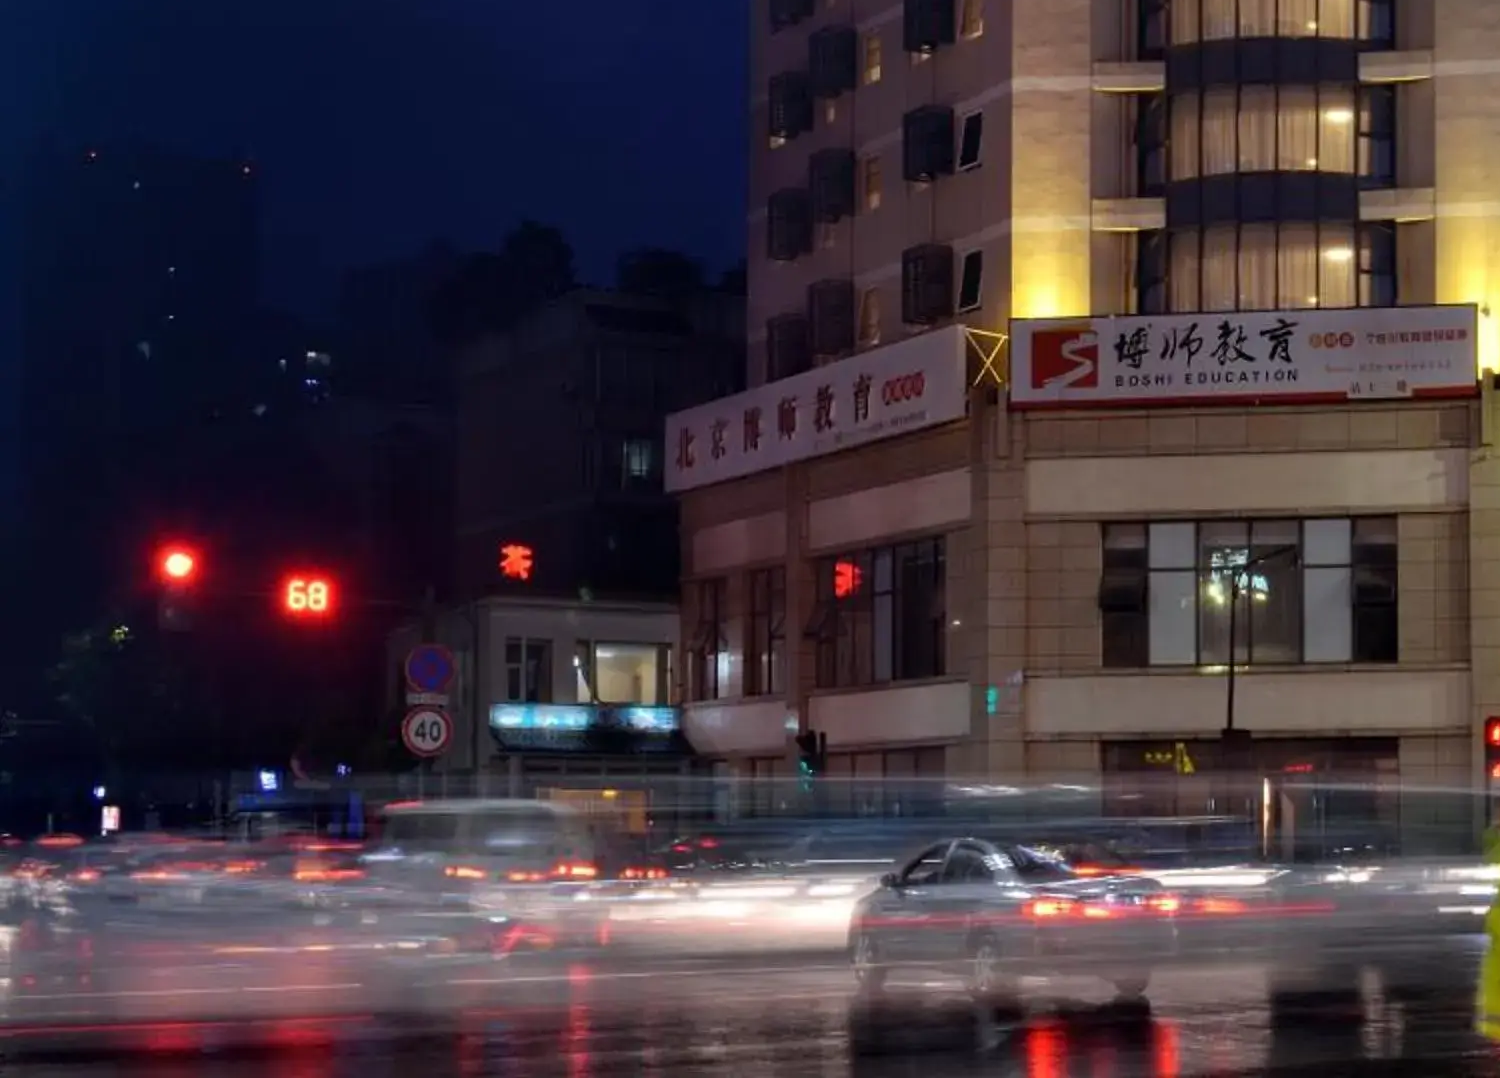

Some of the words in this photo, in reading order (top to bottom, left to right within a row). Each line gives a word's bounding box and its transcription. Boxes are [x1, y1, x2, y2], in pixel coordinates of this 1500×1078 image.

[1113, 318, 1299, 369] 博师教育
[1114, 374, 1173, 388] BOSHI
[1184, 368, 1299, 385] EDUCATION
[286, 579, 329, 611] 68
[414, 719, 441, 743] 40
